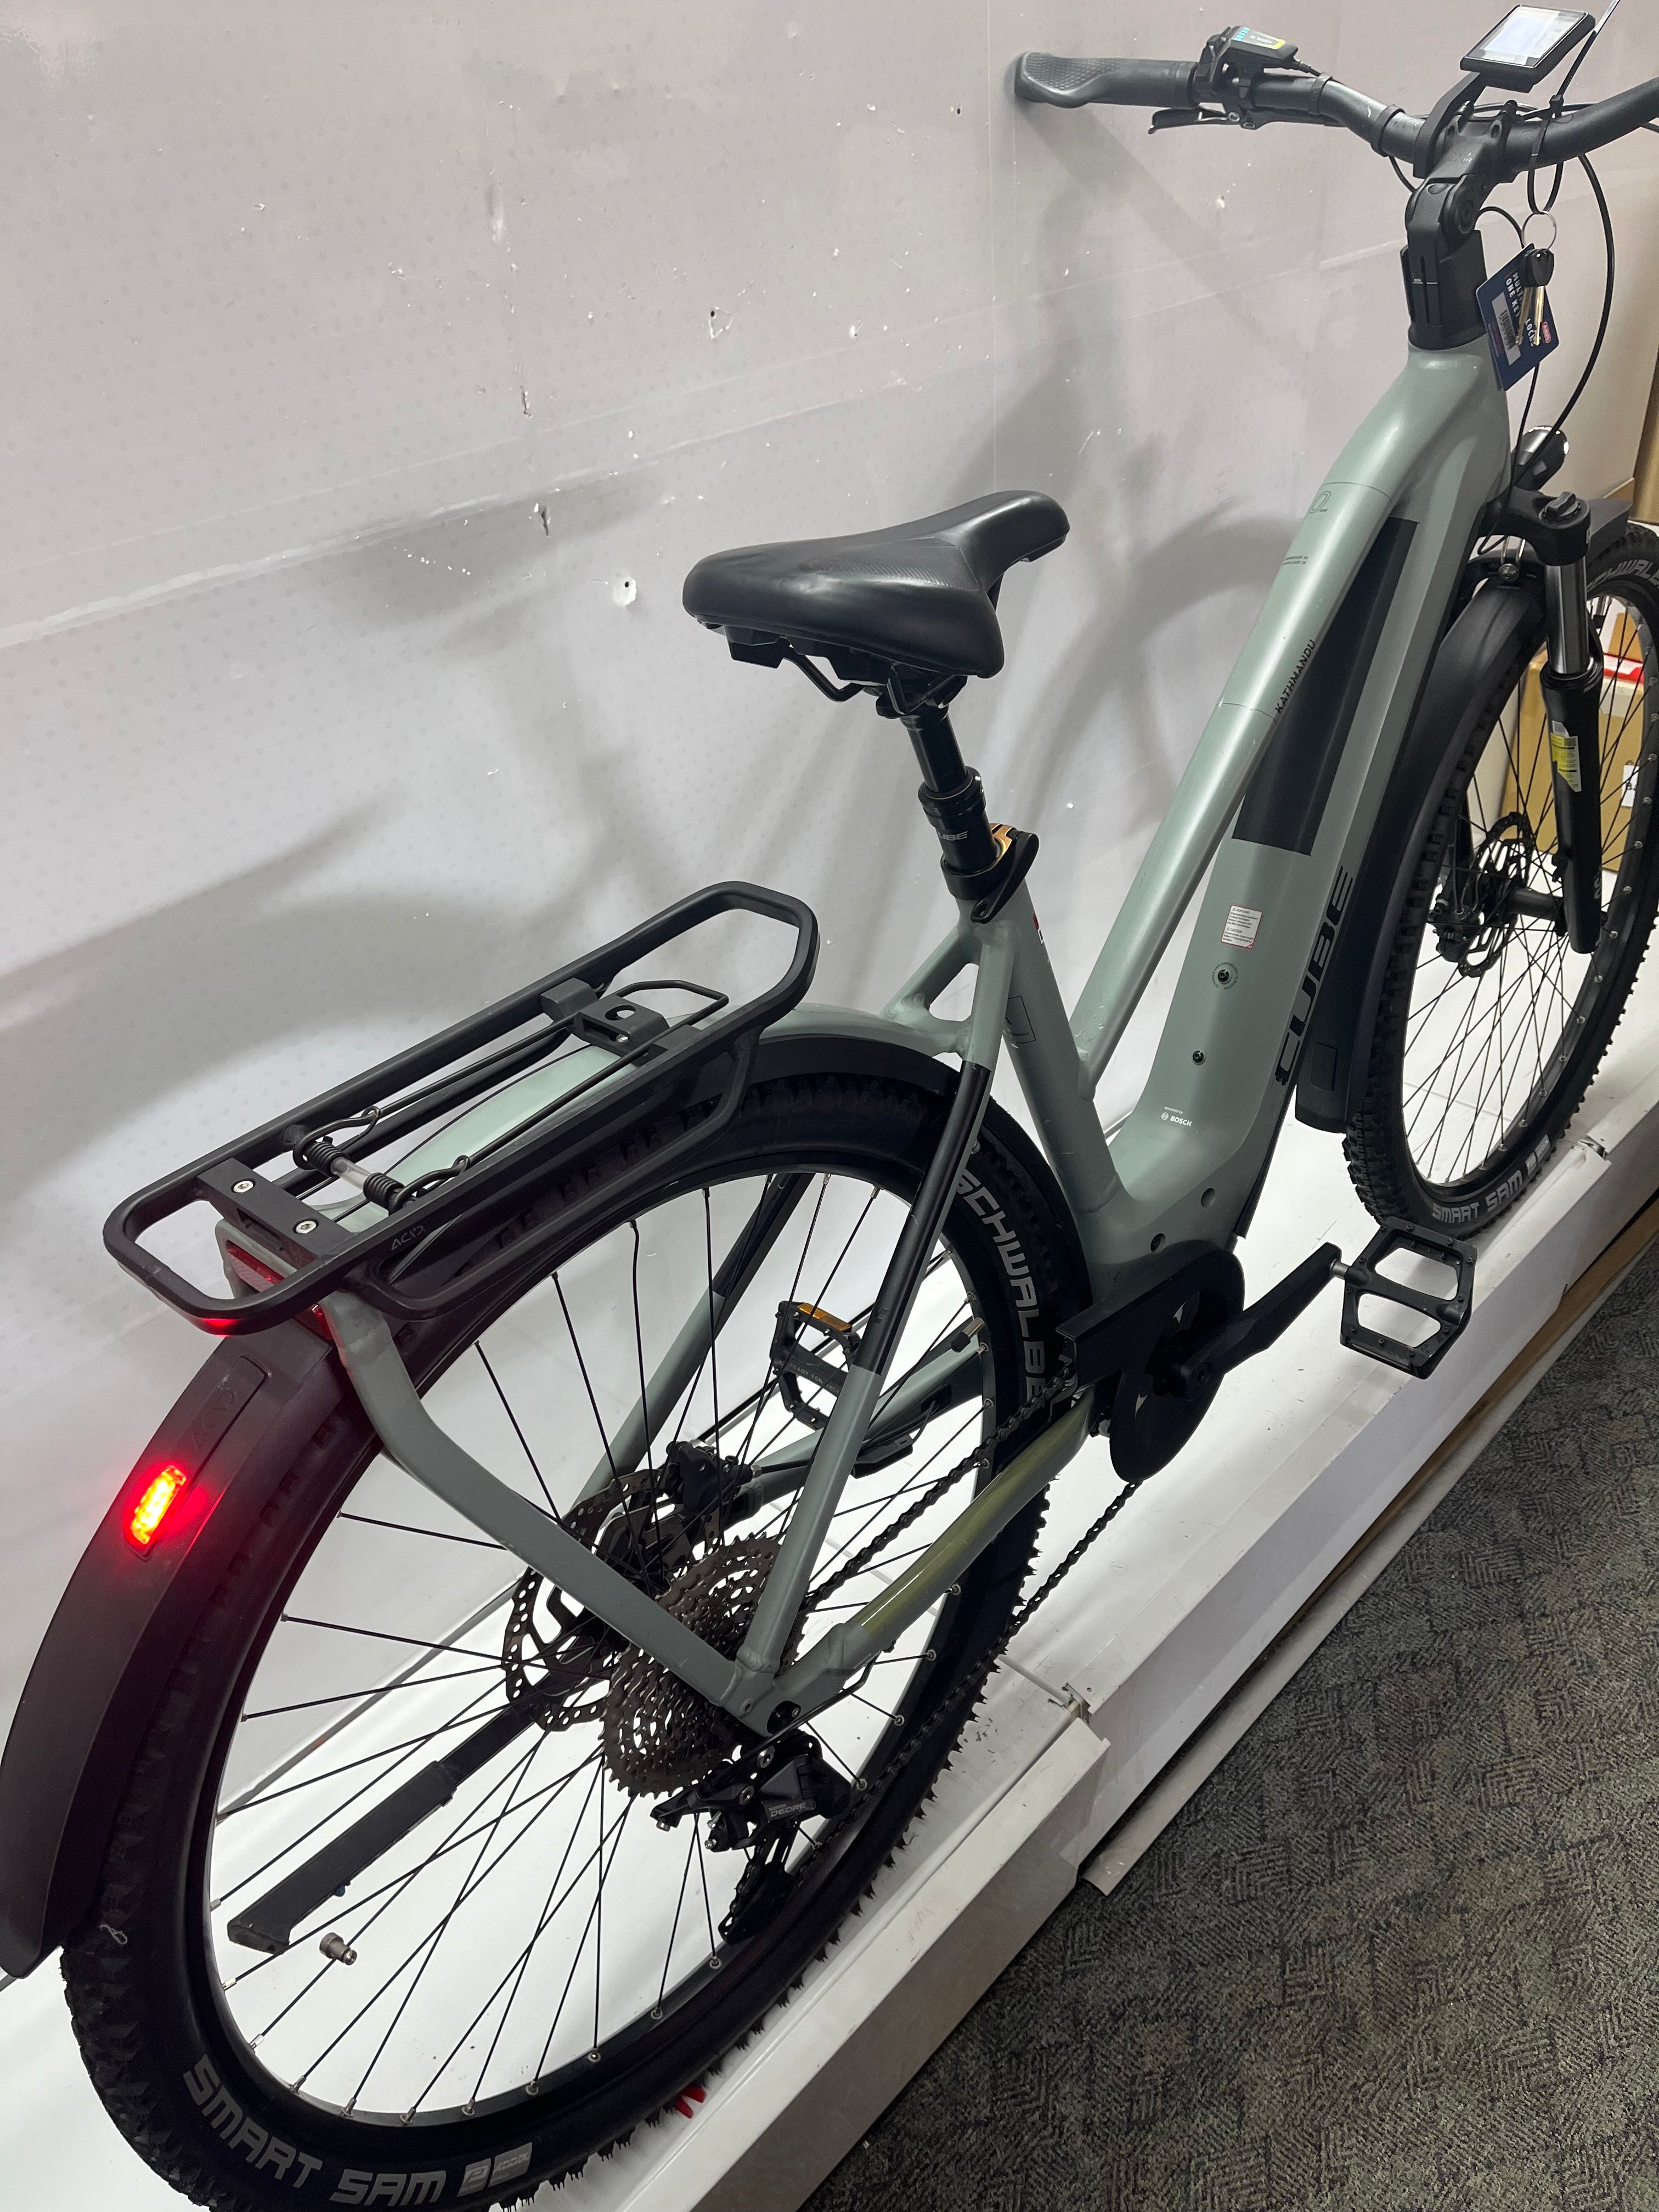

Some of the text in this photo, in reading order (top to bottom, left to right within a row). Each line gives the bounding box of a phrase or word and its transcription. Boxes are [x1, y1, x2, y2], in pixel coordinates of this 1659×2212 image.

[1506, 278, 1516, 298] ONE
[1275, 639, 1316, 714] KATHMANDU
[1274, 866, 1353, 1086] CUBE
[1170, 1115, 1192, 1126] BOSCH
[1432, 1170, 1523, 1223] SMART SAM
[391, 1224, 424, 1250] ACID
[770, 1802, 806, 1818] DEORE
[183, 2053, 323, 2188] SMART
[329, 2168, 447, 2207] SAM
